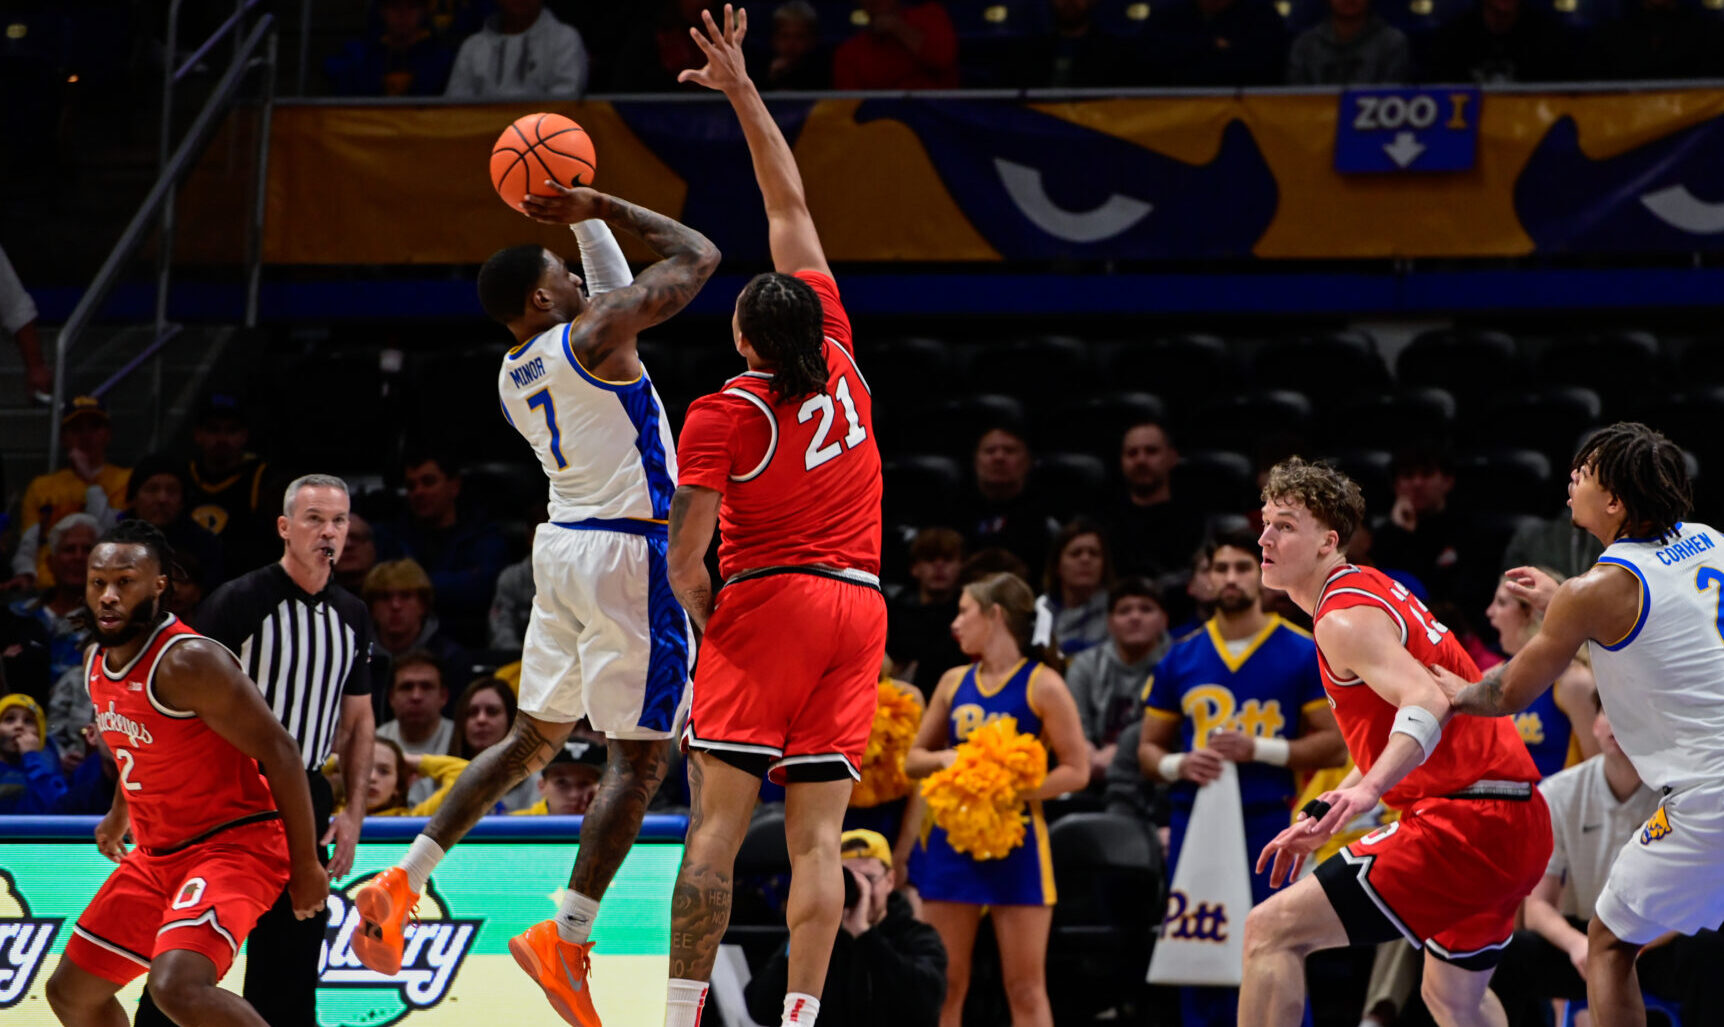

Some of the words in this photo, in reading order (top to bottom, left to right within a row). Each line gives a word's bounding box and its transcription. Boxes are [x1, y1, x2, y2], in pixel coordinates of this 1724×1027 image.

[1353, 95, 1438, 130] ZOO
[1446, 94, 1469, 129] I
[509, 356, 546, 389] MINOR
[526, 385, 570, 472] 7
[797, 374, 868, 472] 21
[1655, 531, 1716, 566] CORHEN
[93, 700, 153, 749] uckeyes
[116, 748, 142, 791] 2
